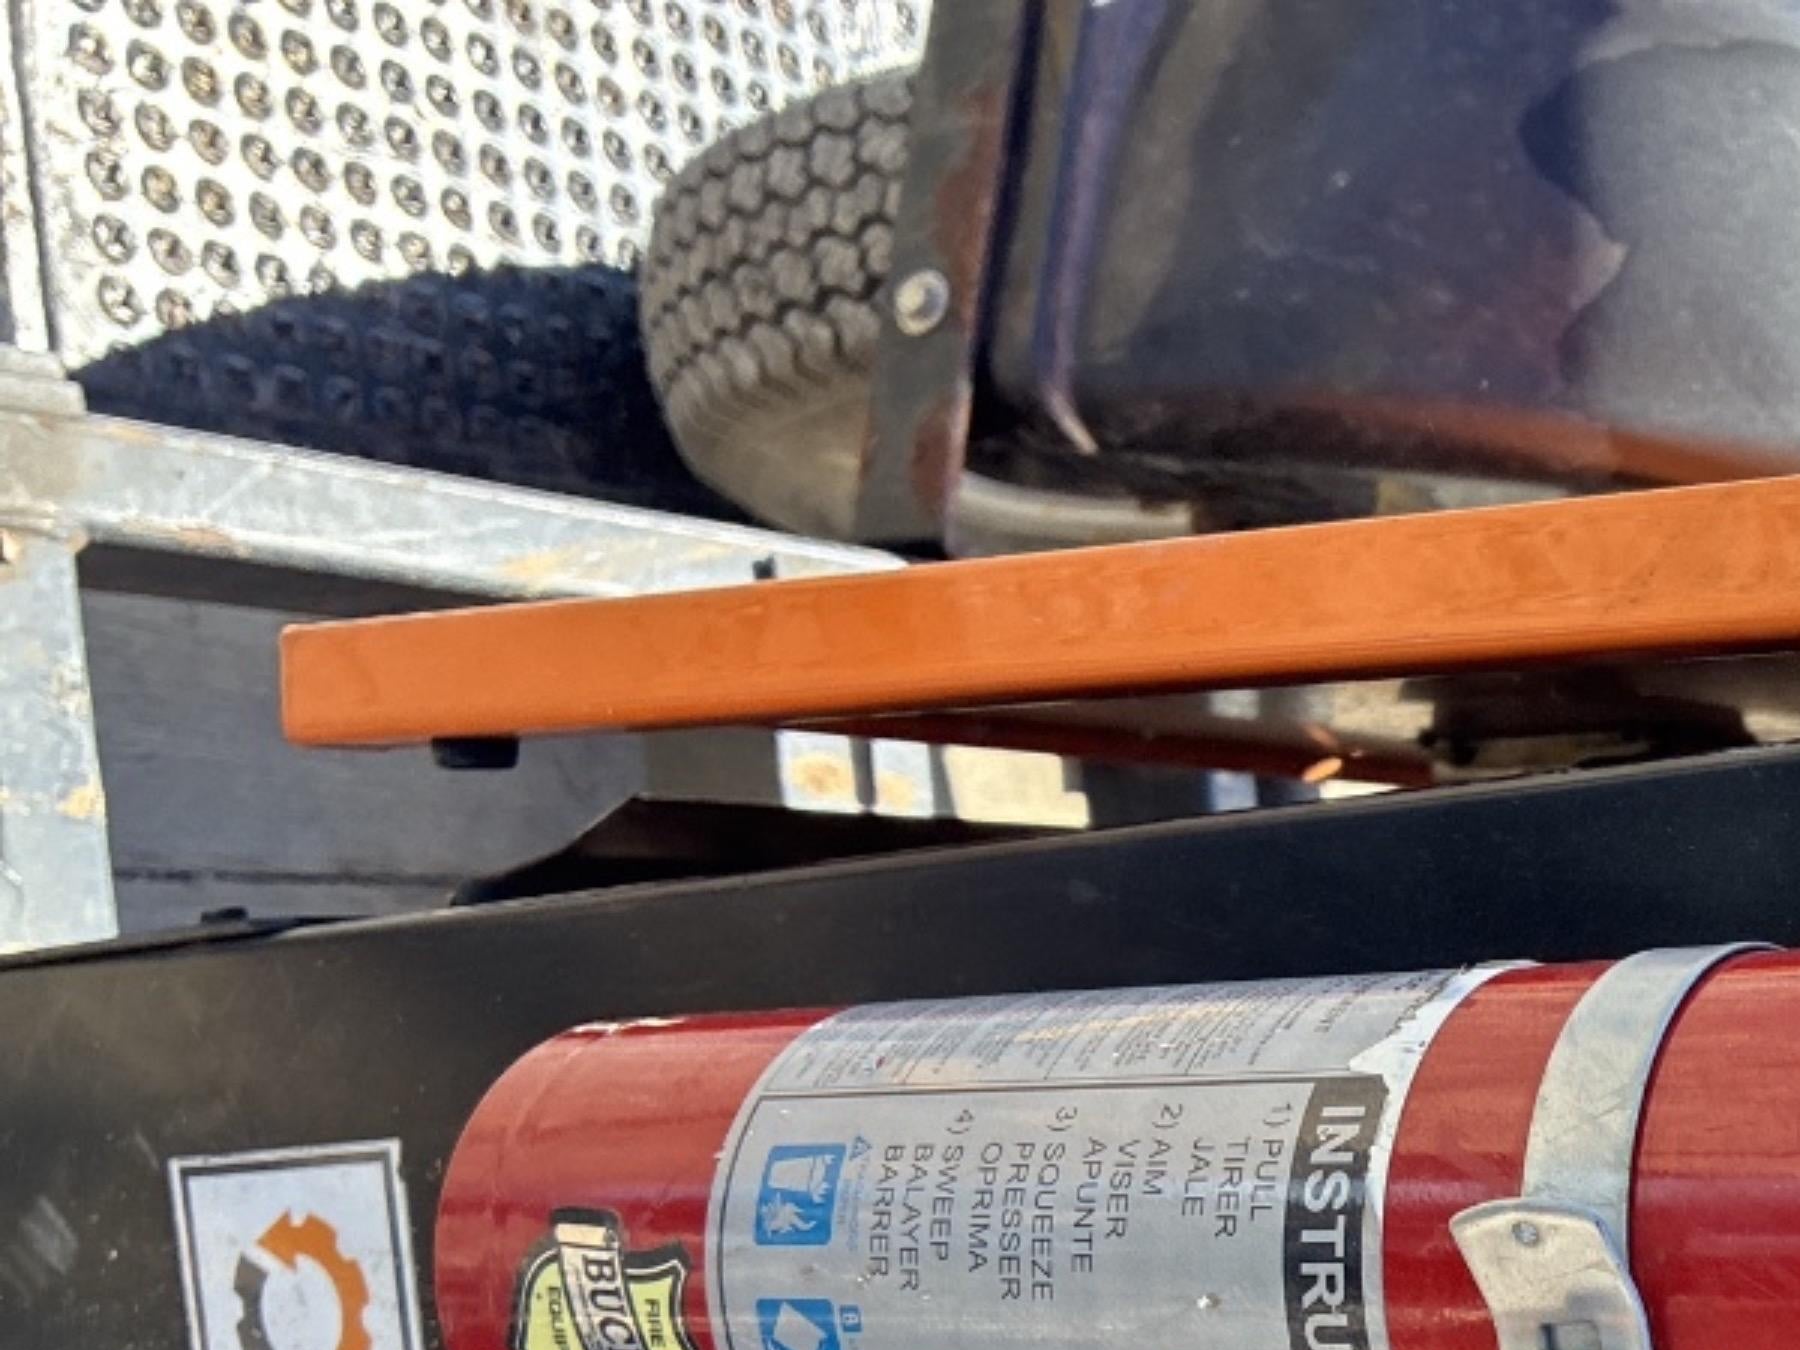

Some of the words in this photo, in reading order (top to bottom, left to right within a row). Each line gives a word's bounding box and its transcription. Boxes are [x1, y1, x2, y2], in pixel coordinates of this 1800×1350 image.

[946, 1108, 974, 1136] 4)
[1047, 1105, 1077, 1132] 3)
[1150, 1104, 1182, 1130] 2)
[1263, 1102, 1293, 1128] 1)
[869, 1145, 902, 1277] BARRER
[929, 1144, 963, 1261] SWEEP
[968, 1142, 1002, 1273] OPRIMA
[1070, 1137, 1105, 1273] APUNTE
[1105, 1140, 1139, 1239] VISER
[1142, 1139, 1170, 1196] AIM
[1181, 1138, 1214, 1217] JALE
[1214, 1137, 1249, 1239] TIRER
[1250, 1139, 1284, 1222] PULL
[899, 1144, 933, 1291] BALAYER
[1000, 1142, 1034, 1301] PRESSER
[1031, 1142, 1066, 1301] SQUEEZE
[644, 1299, 667, 1348] FIRE
